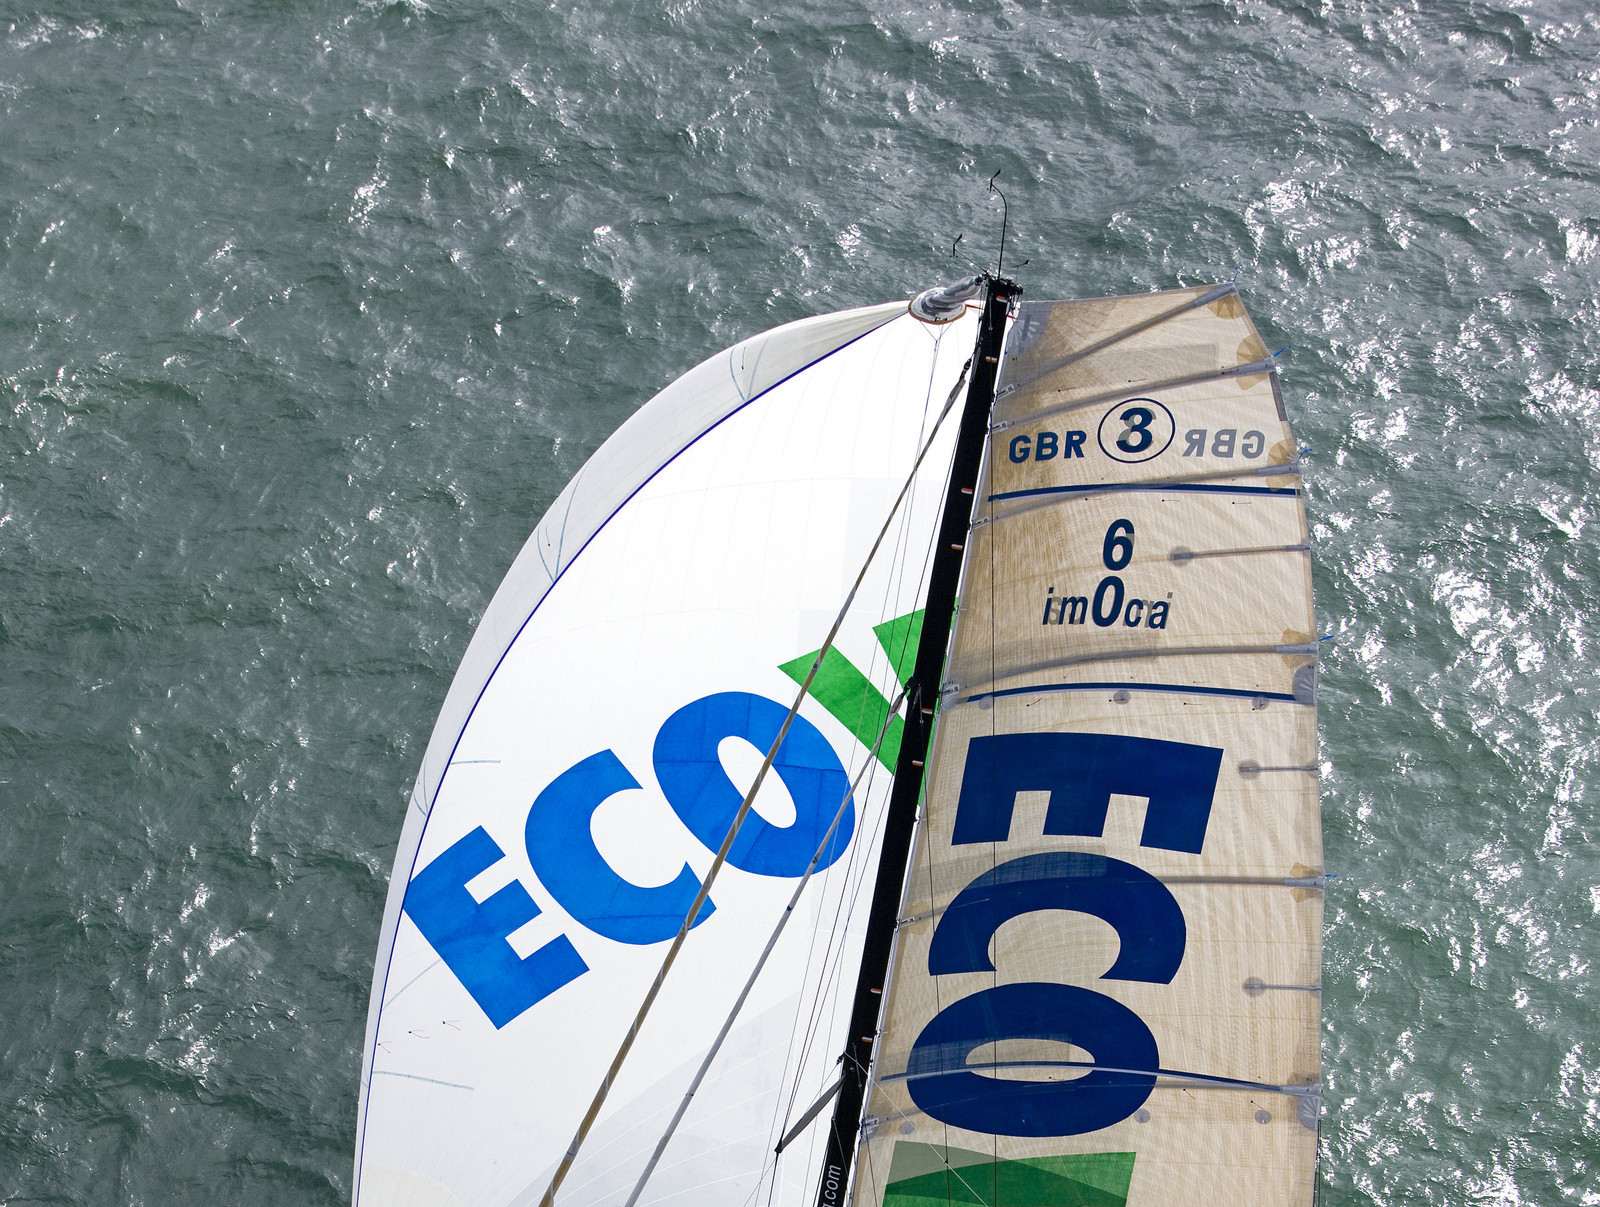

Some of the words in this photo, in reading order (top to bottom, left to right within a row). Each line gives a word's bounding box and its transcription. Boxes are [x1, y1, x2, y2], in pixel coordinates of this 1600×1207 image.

[1009, 430, 1087, 463] GBR
[1116, 407, 1155, 453] 3
[1102, 518, 1135, 571] 6
